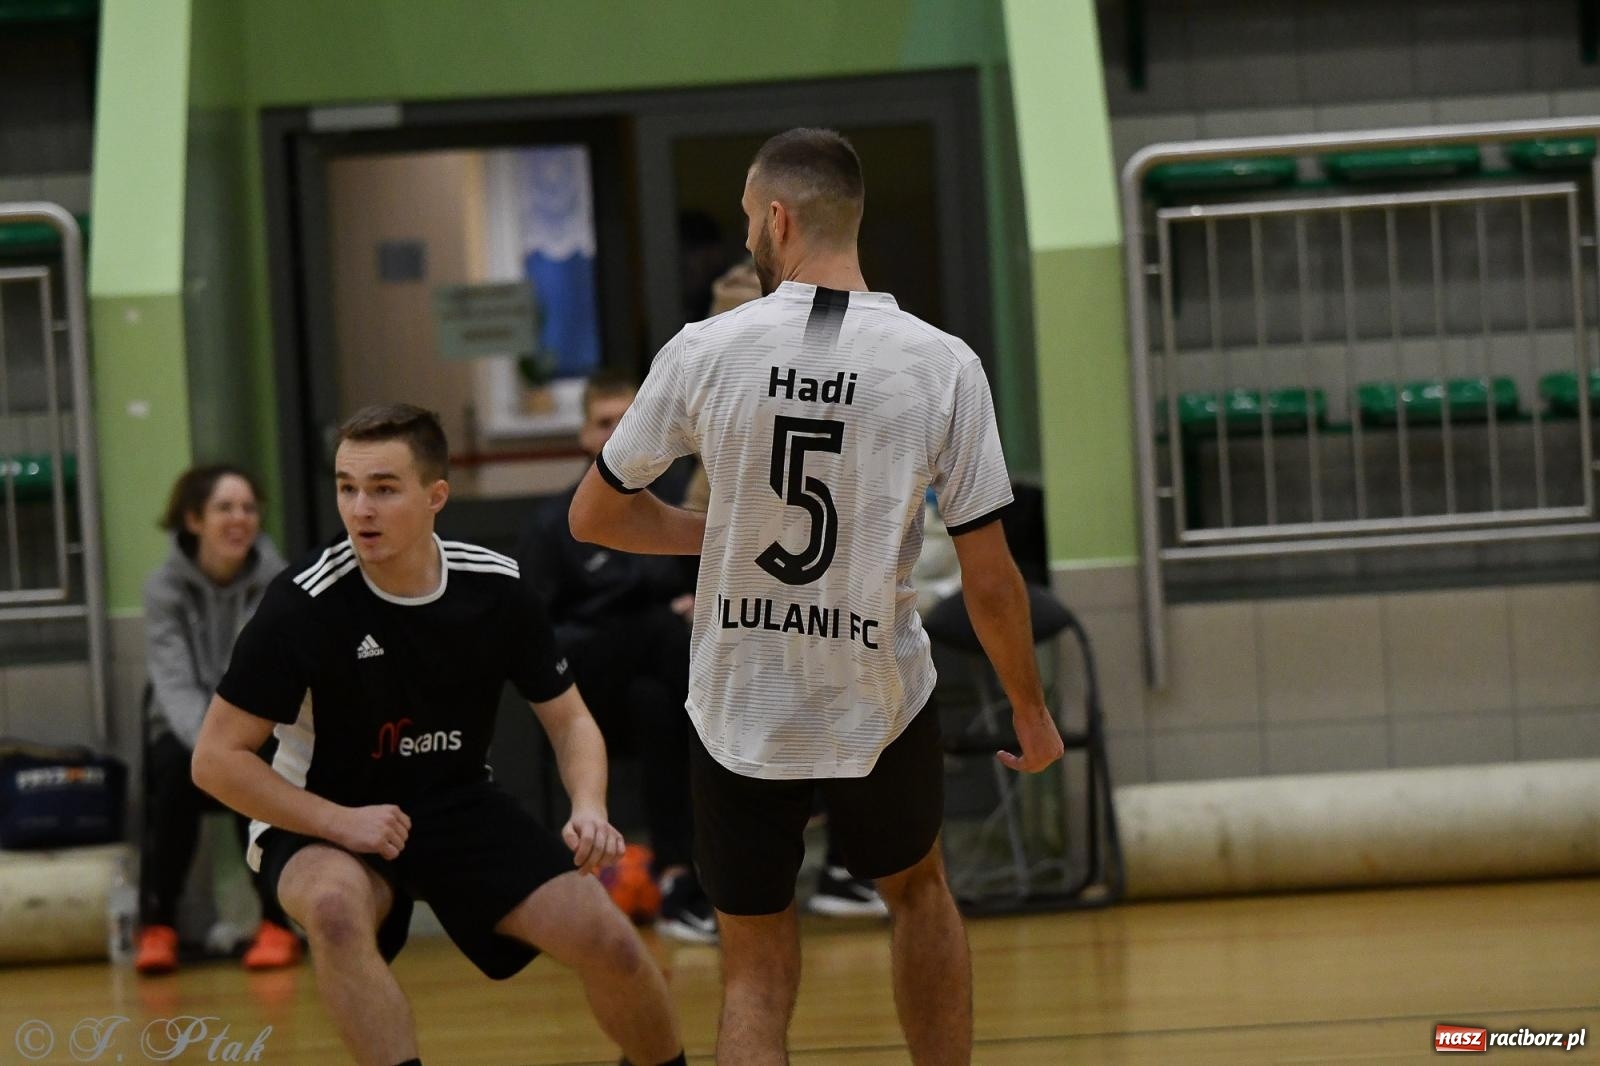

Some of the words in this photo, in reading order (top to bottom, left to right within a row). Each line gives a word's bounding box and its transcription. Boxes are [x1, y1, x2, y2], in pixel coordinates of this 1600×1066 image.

[768, 366, 858, 406] Hadi
[754, 414, 845, 586] 5
[718, 594, 840, 639] LULANI
[850, 611, 879, 650] FC
[357, 647, 385, 660] adidas
